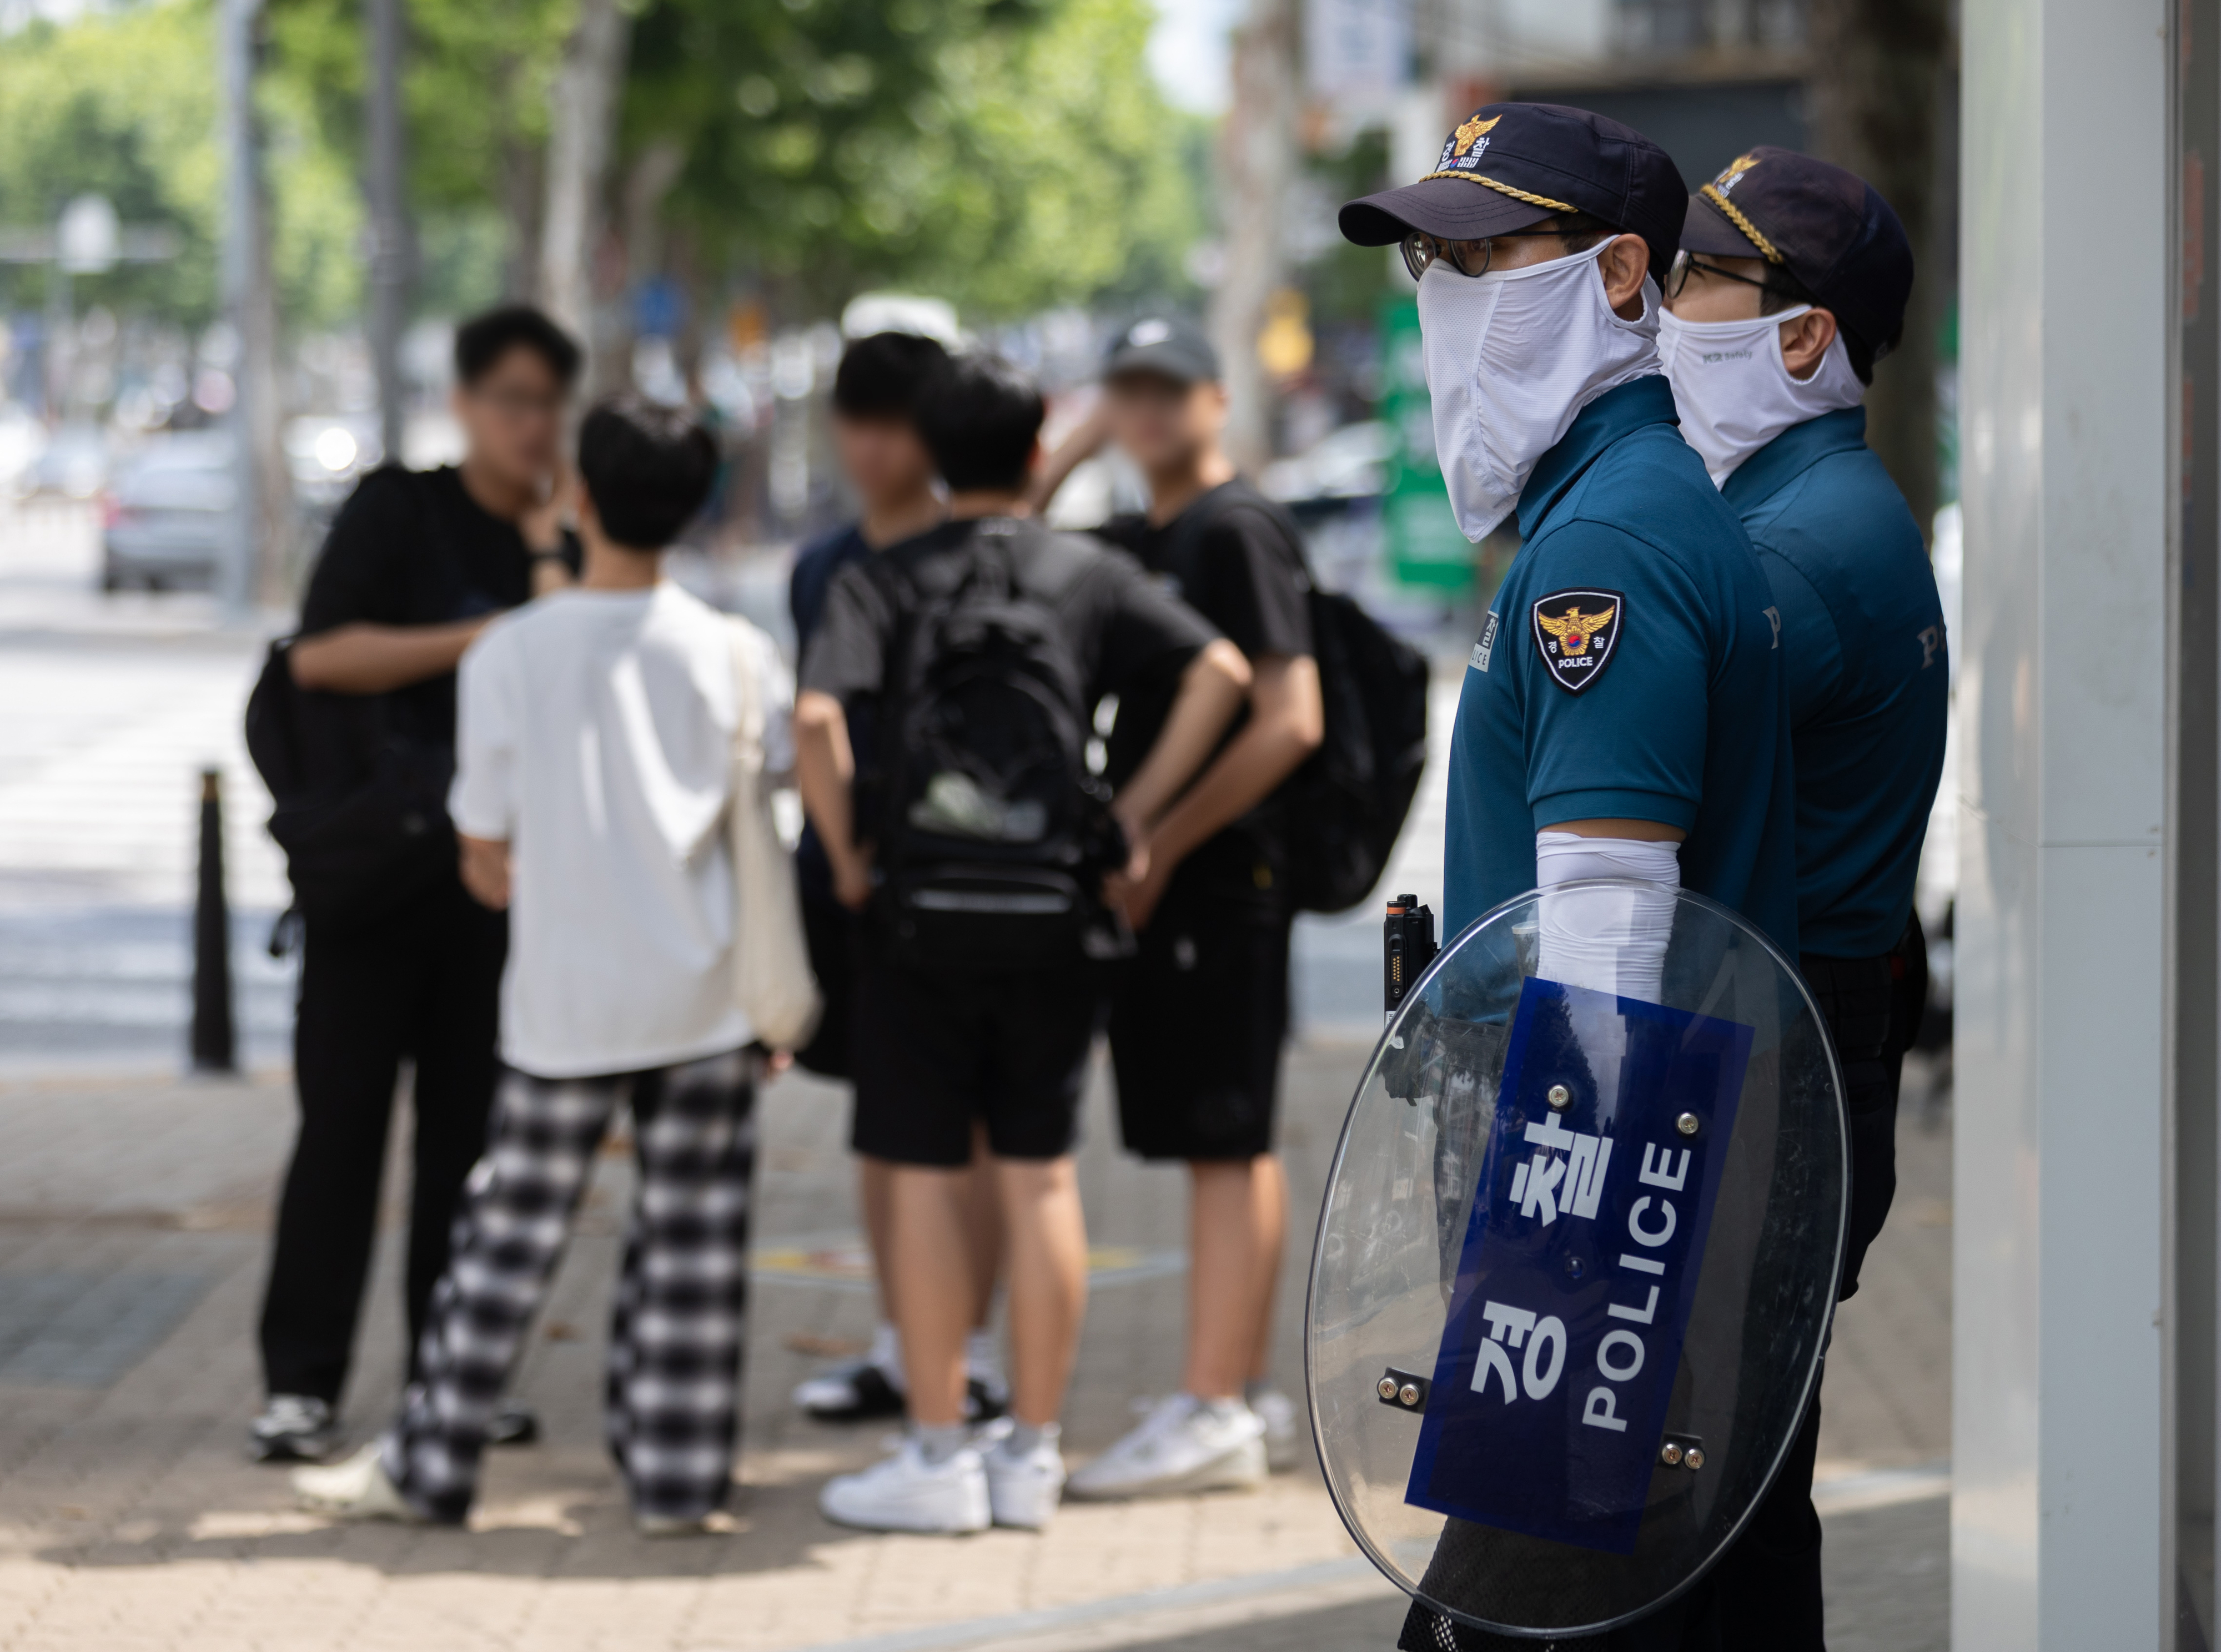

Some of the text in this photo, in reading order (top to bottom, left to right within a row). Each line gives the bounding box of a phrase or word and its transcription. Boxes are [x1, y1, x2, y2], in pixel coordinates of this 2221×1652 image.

[1471, 137, 1490, 158] 찰
[1702, 352, 1723, 364] K2
[1593, 636, 1605, 649] 찰
[1558, 656, 1593, 669] POLICE
[1582, 1142, 1691, 1433] POLICE
